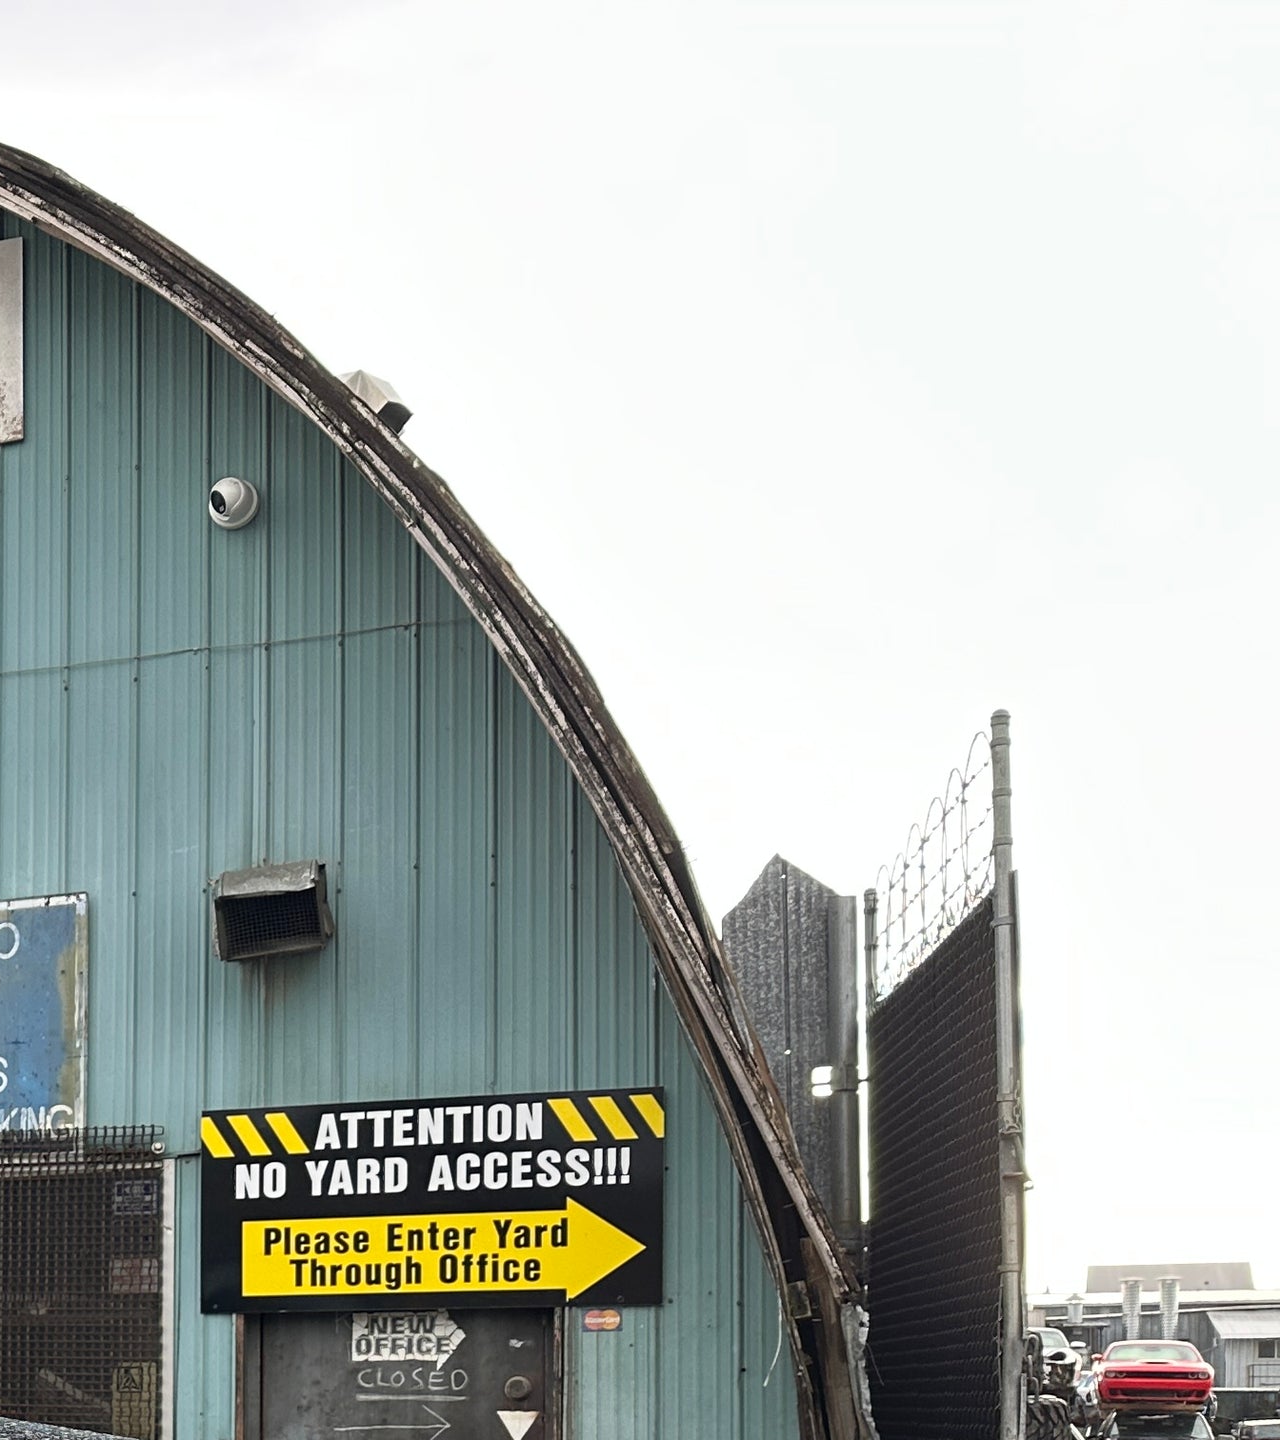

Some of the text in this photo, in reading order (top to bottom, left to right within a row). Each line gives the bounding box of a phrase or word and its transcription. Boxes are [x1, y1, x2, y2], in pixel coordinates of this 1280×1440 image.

[314, 1102, 543, 1151] ATTENTION
[235, 1146, 631, 1200] NO YARD ACCESS!!!
[264, 1217, 569, 1255] Please Enter Yard
[290, 1253, 541, 1290] Through Office
[369, 1314, 435, 1335] NEW
[355, 1334, 452, 1356] OFFICE
[357, 1367, 469, 1391] CLOSED
